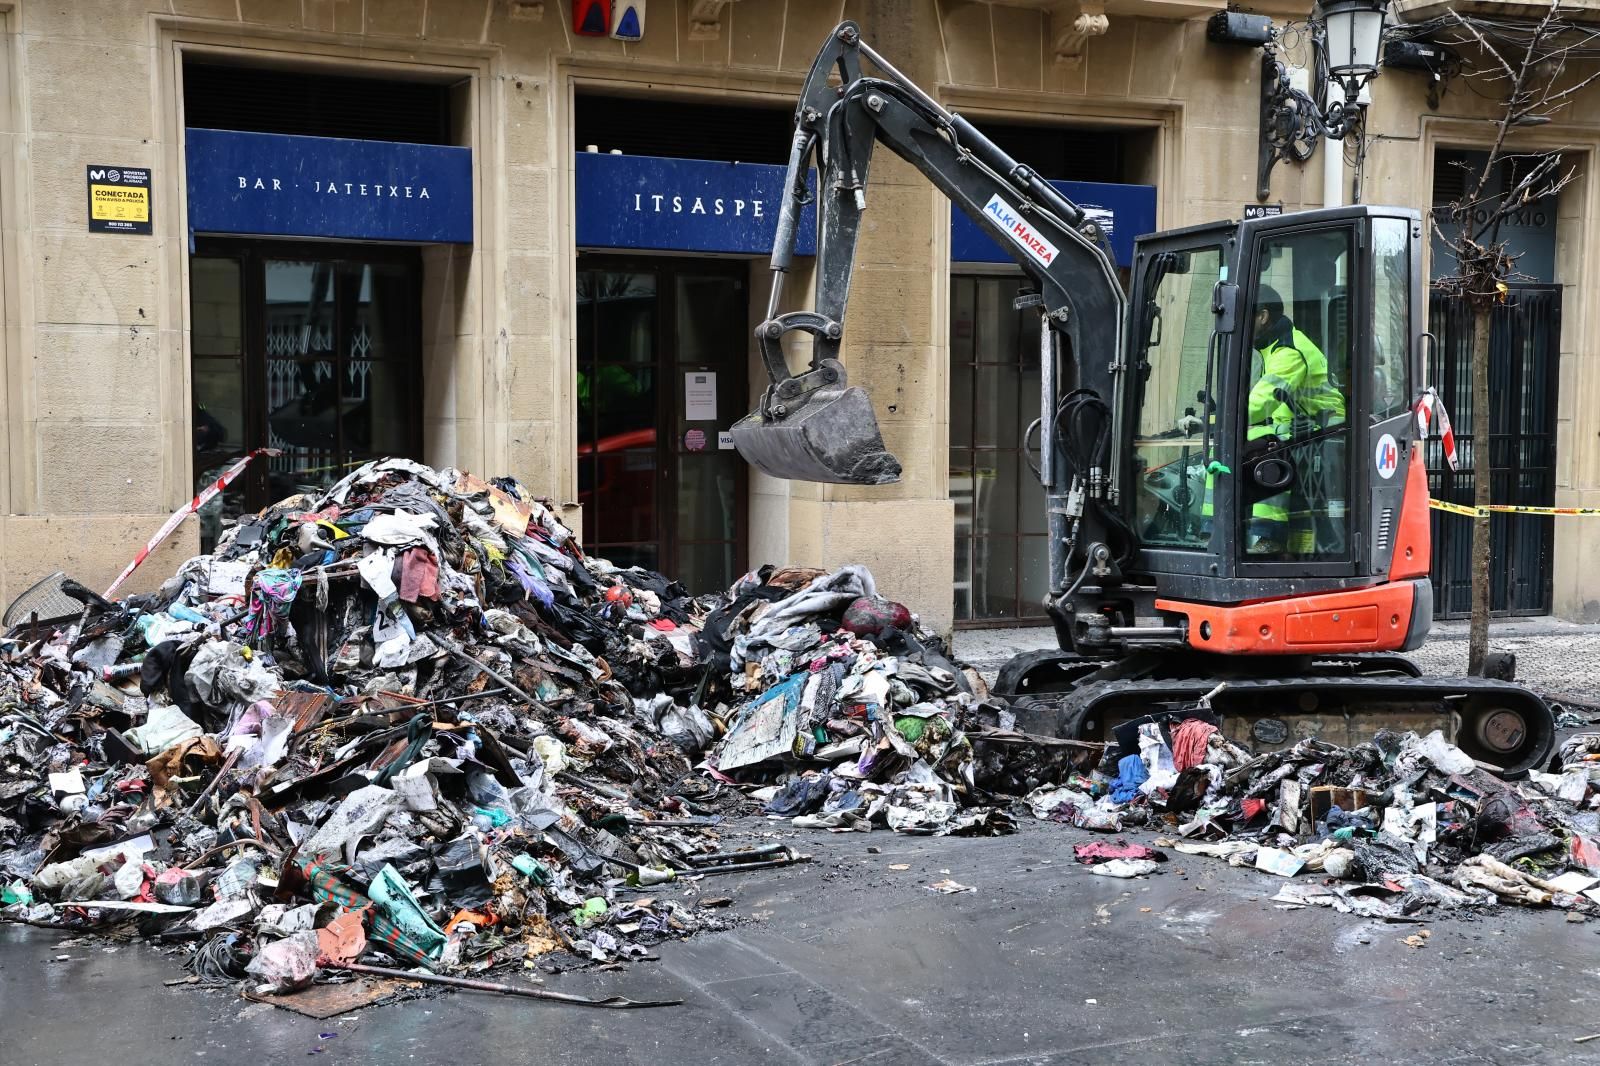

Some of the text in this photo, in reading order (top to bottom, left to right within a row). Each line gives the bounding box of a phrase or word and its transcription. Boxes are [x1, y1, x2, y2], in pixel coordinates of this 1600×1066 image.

[95, 190, 144, 198] CONECTADA
[238, 176, 430, 199] BAR JATETXEA
[634, 193, 764, 217] ITSASPE
[987, 201, 1053, 263] ALKI HAIZEA
